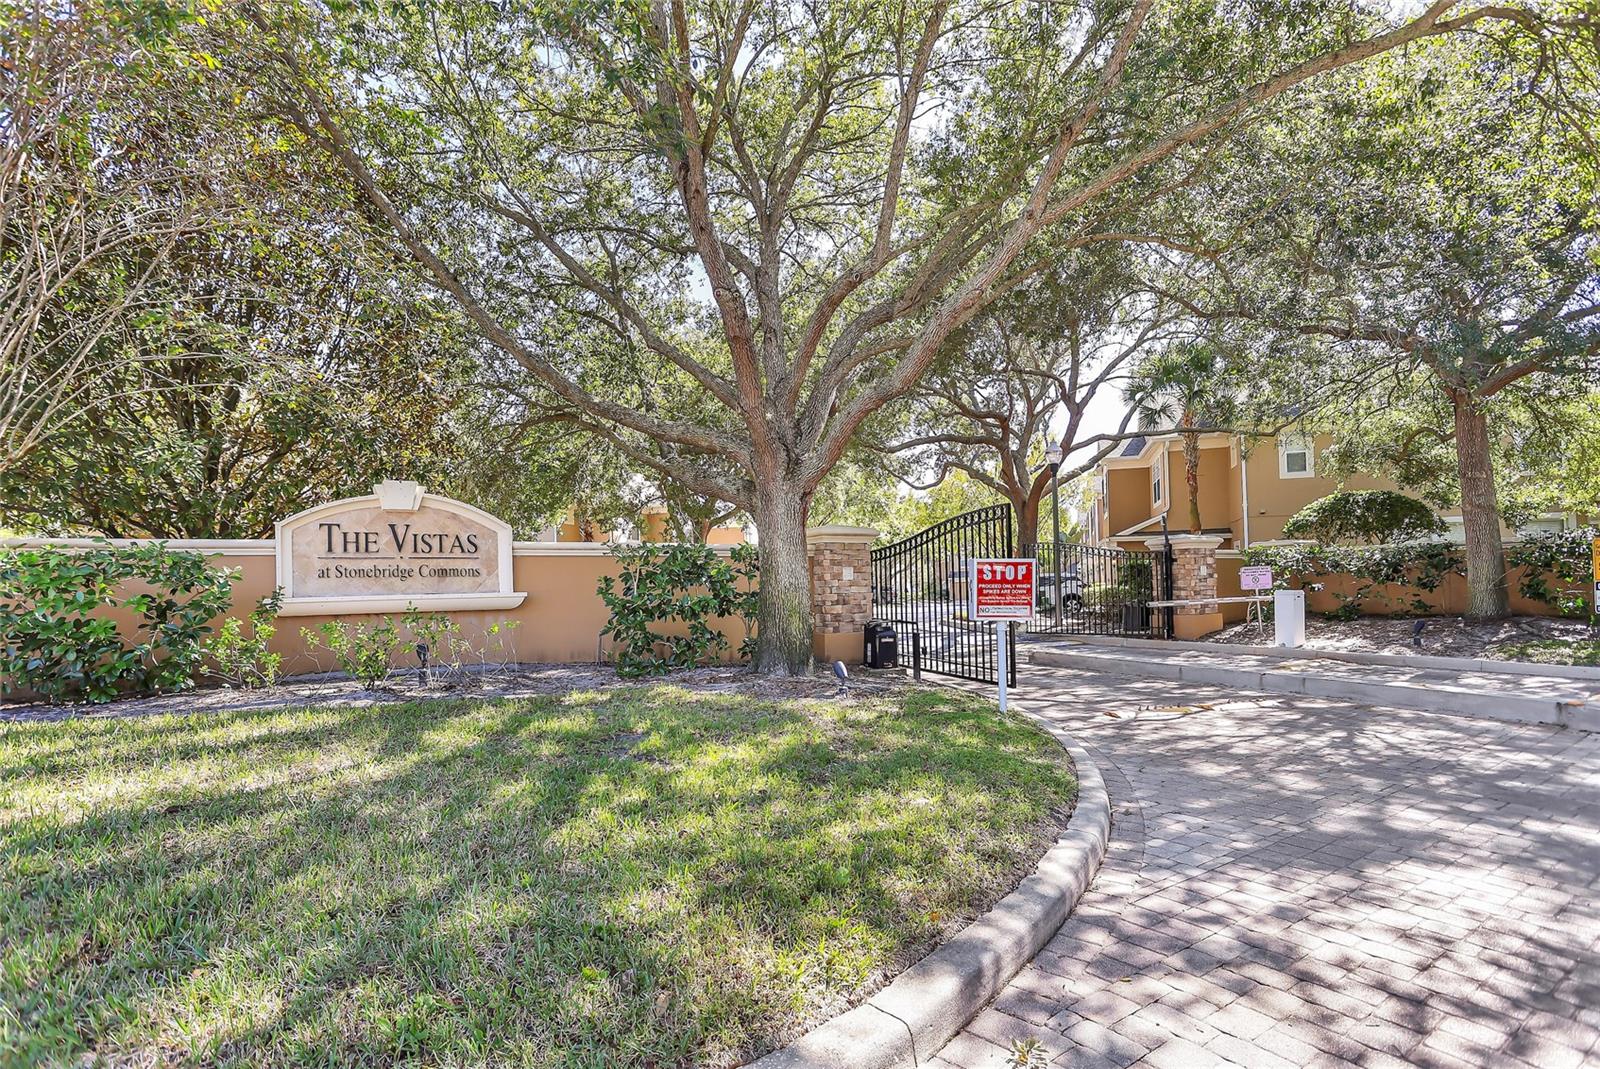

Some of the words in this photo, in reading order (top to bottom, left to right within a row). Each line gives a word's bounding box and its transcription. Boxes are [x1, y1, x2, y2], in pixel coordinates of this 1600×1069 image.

[319, 523, 380, 553] THE
[387, 523, 479, 554] VISTAS
[317, 566, 330, 578] at
[335, 564, 414, 581] Stonebridge
[418, 564, 481, 578] Commons
[982, 564, 1027, 580] STOP
